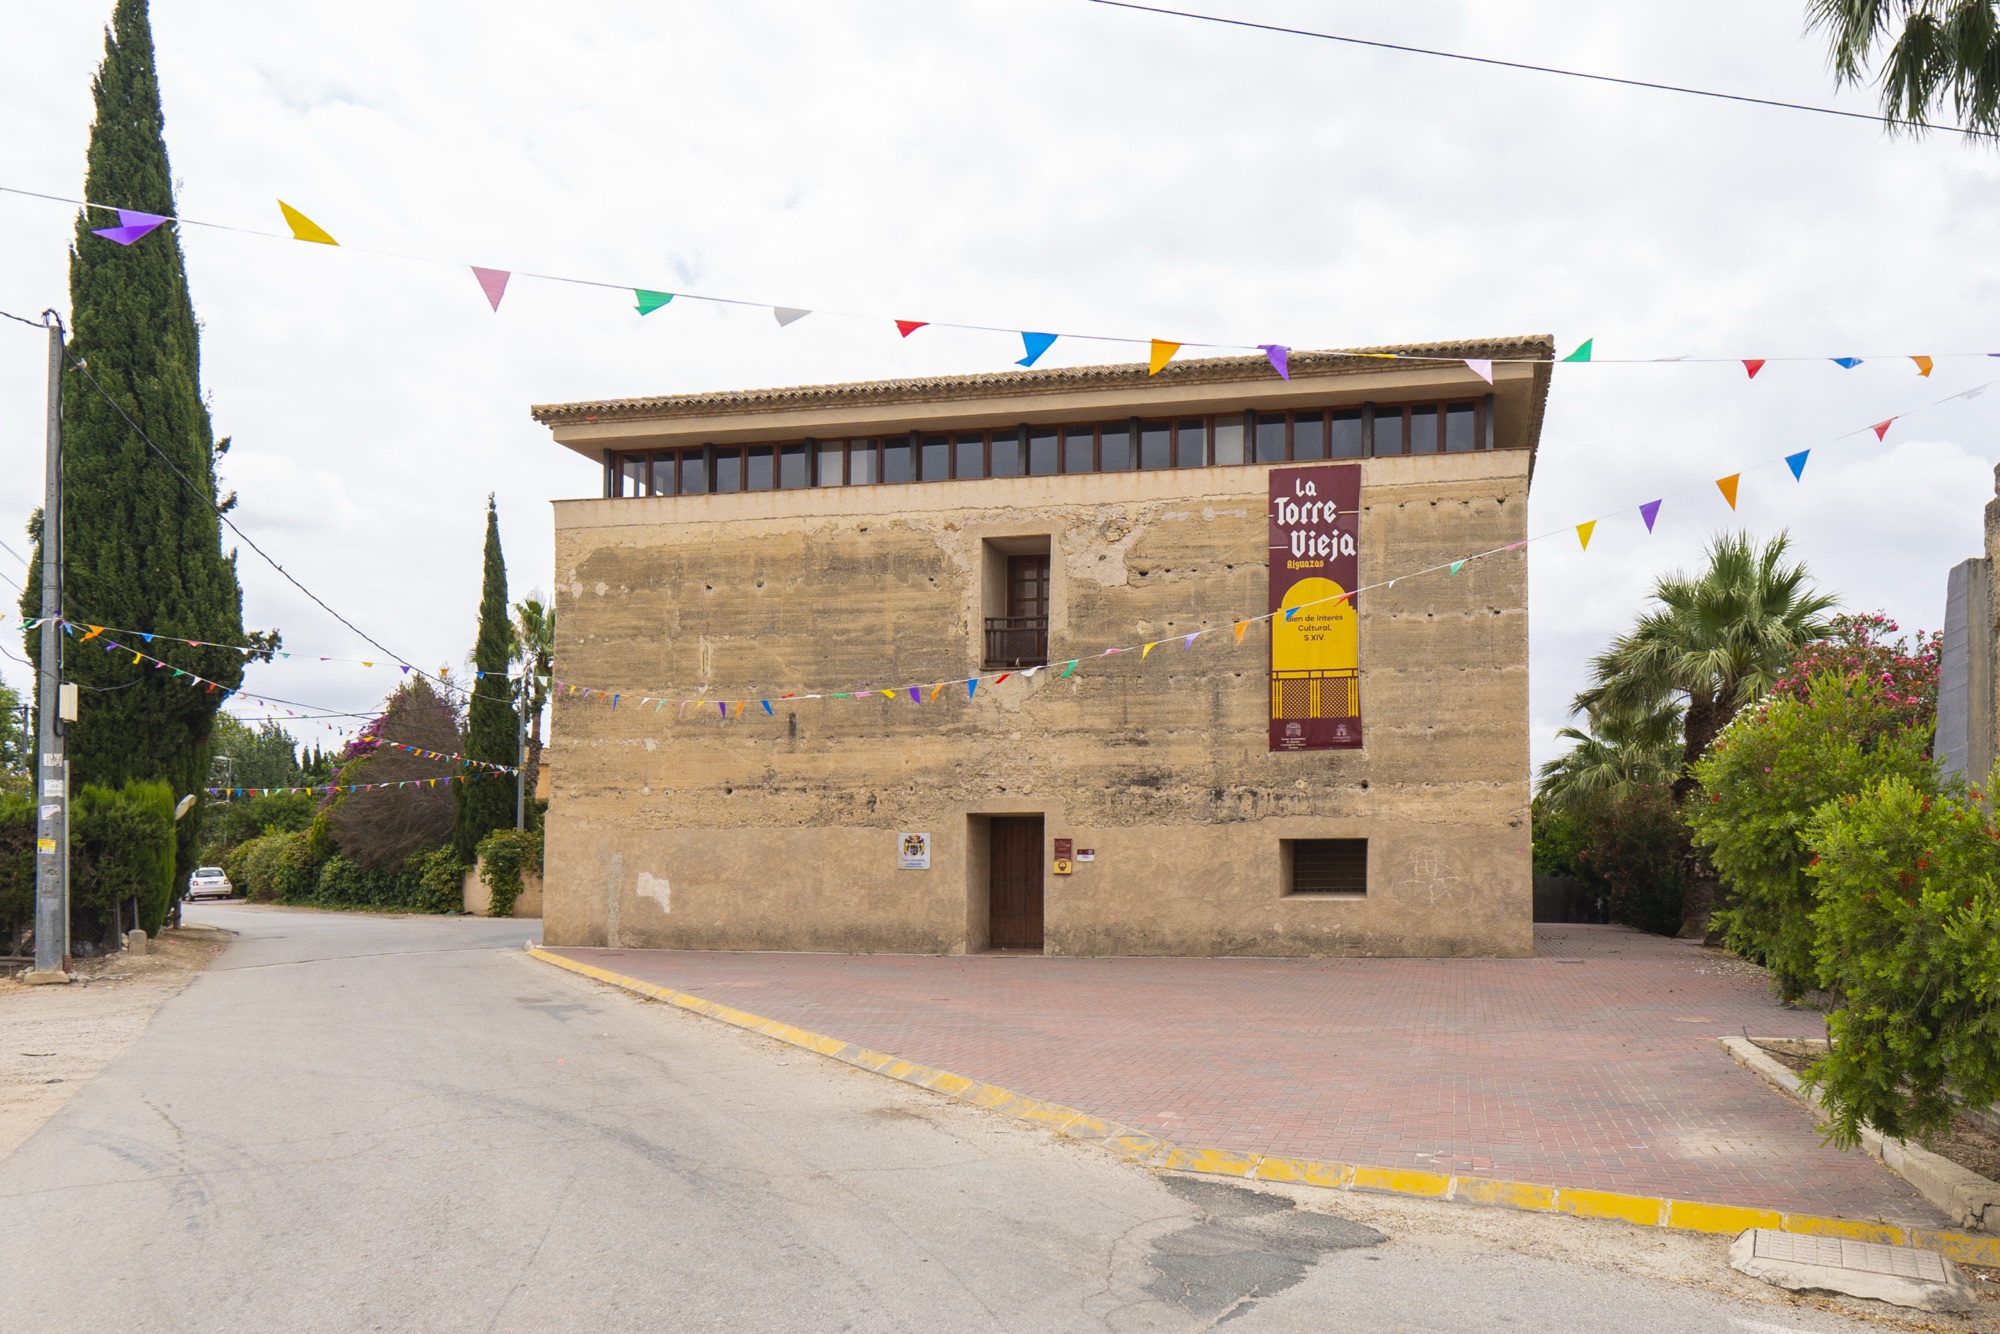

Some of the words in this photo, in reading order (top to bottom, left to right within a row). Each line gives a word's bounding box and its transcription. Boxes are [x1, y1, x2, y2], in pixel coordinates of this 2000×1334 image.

[1295, 478, 1317, 497] La
[1273, 497, 1337, 526] Torre
[1290, 529, 1357, 562] Vieja
[1287, 560, 1324, 570] Alguazas
[1305, 613, 1315, 622] de
[1316, 613, 1343, 622] Interés
